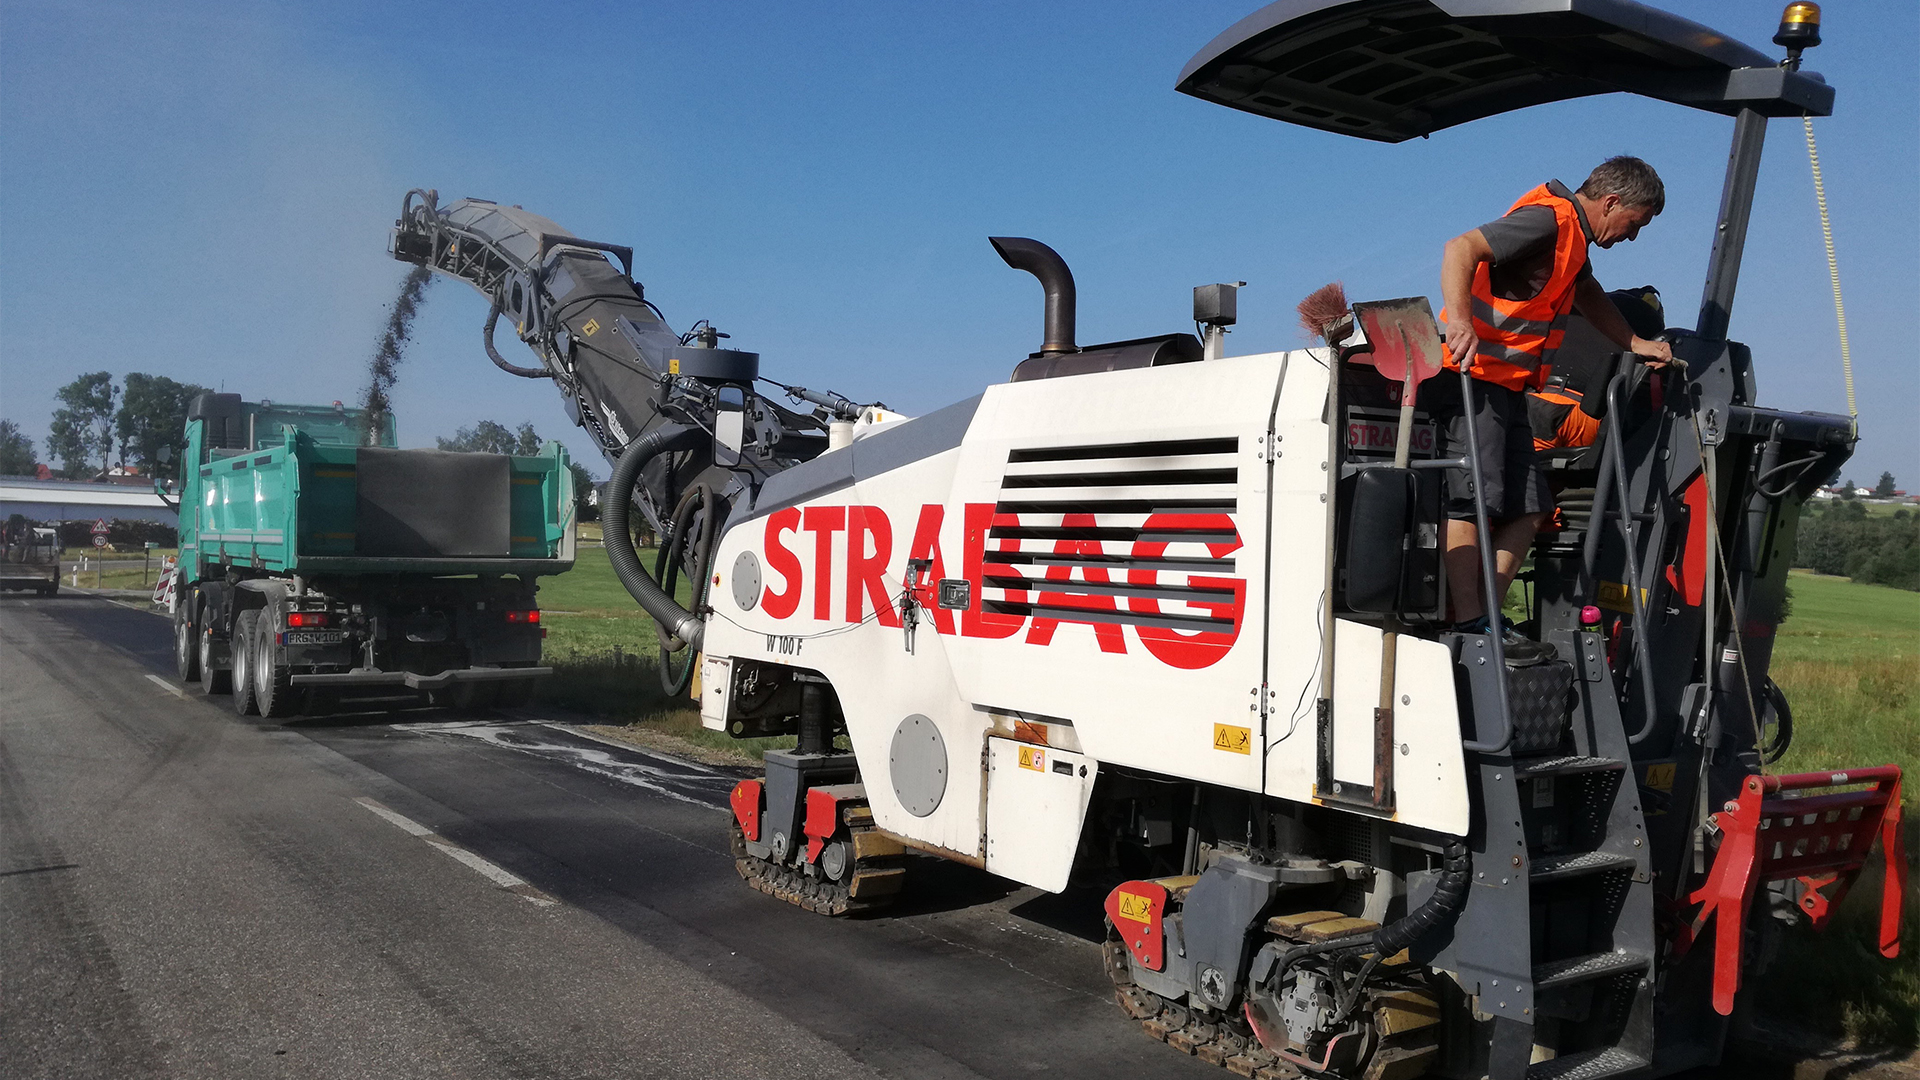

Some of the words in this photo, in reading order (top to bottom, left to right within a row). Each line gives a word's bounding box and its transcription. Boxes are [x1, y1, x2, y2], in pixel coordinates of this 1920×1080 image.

[1348, 423, 1432, 450] STRAAG
[95, 537, 105, 545] 70
[761, 503, 1247, 669] STRABAG
[767, 634, 776, 652] W
[779, 635, 795, 655] 100
[796, 638, 803, 656] F
